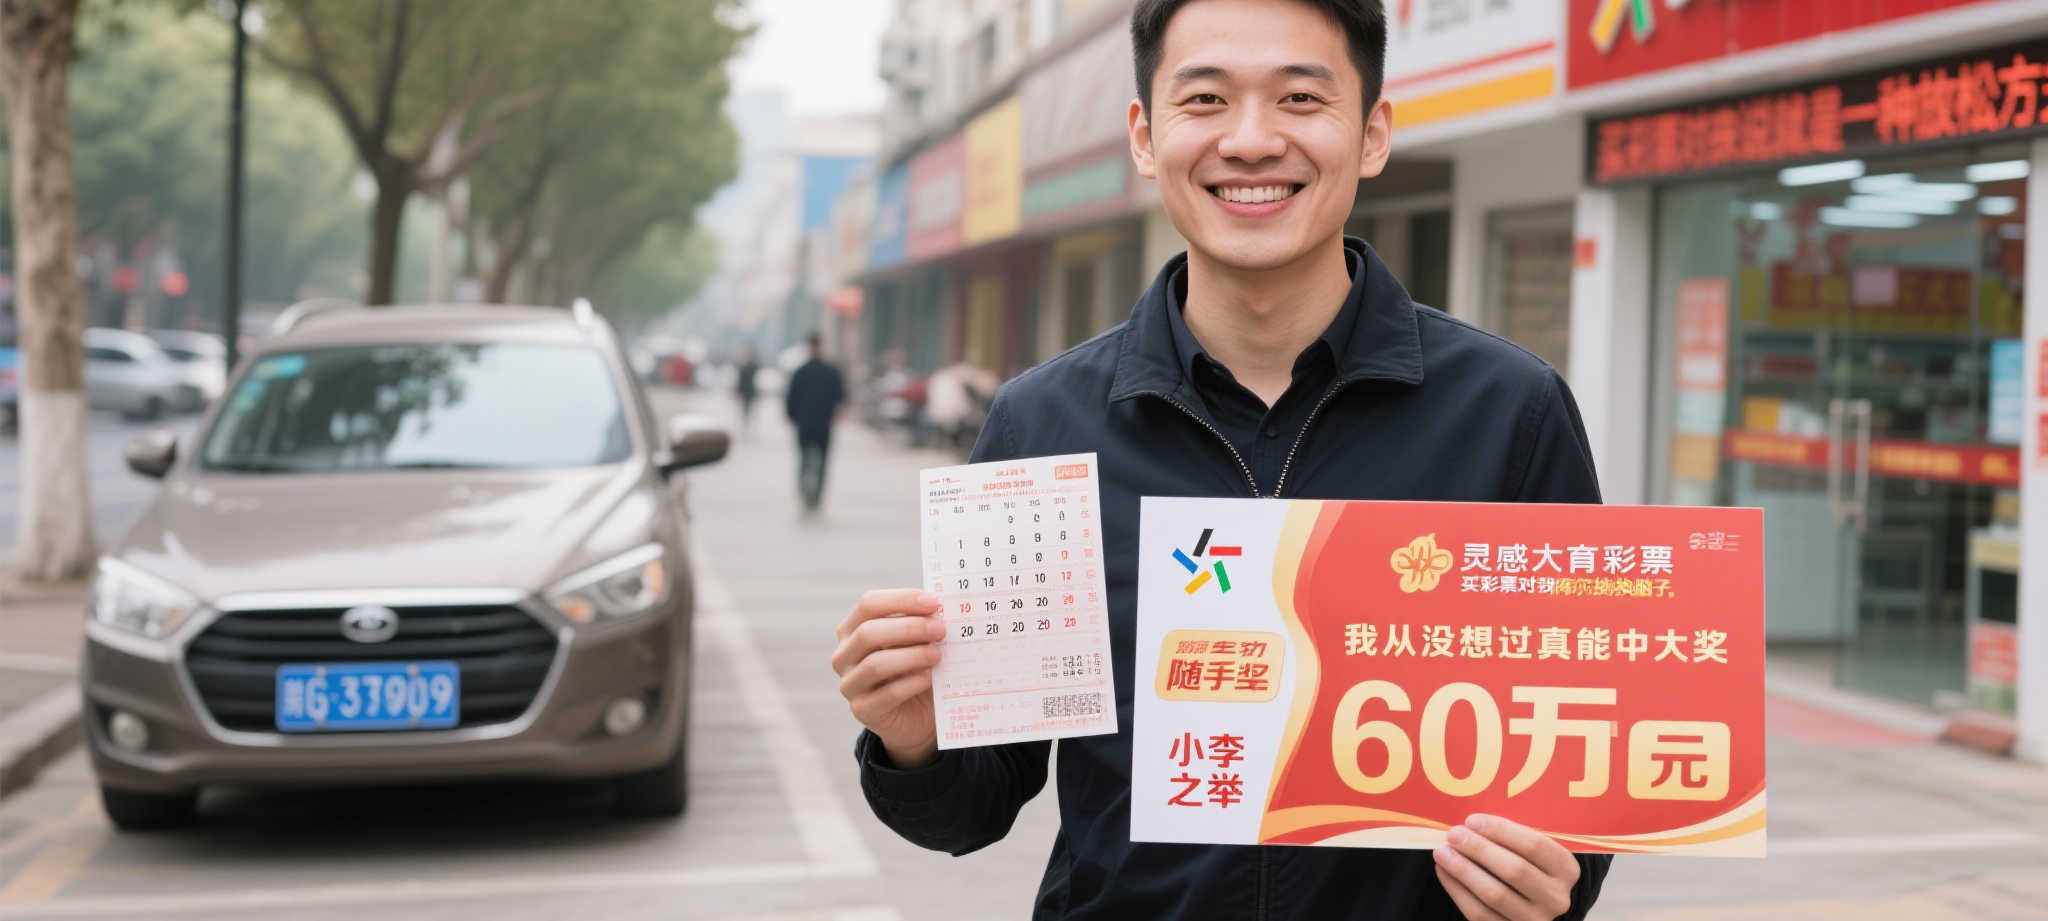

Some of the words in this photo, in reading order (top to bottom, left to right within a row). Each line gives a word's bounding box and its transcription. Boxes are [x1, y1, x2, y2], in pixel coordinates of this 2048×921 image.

[1460, 543, 1673, 574] 灵感大育彩票
[1344, 623, 1729, 664] 我从没想过真能中大奖
[1168, 732, 1245, 768] 小李
[1167, 772, 1244, 808] 之举
